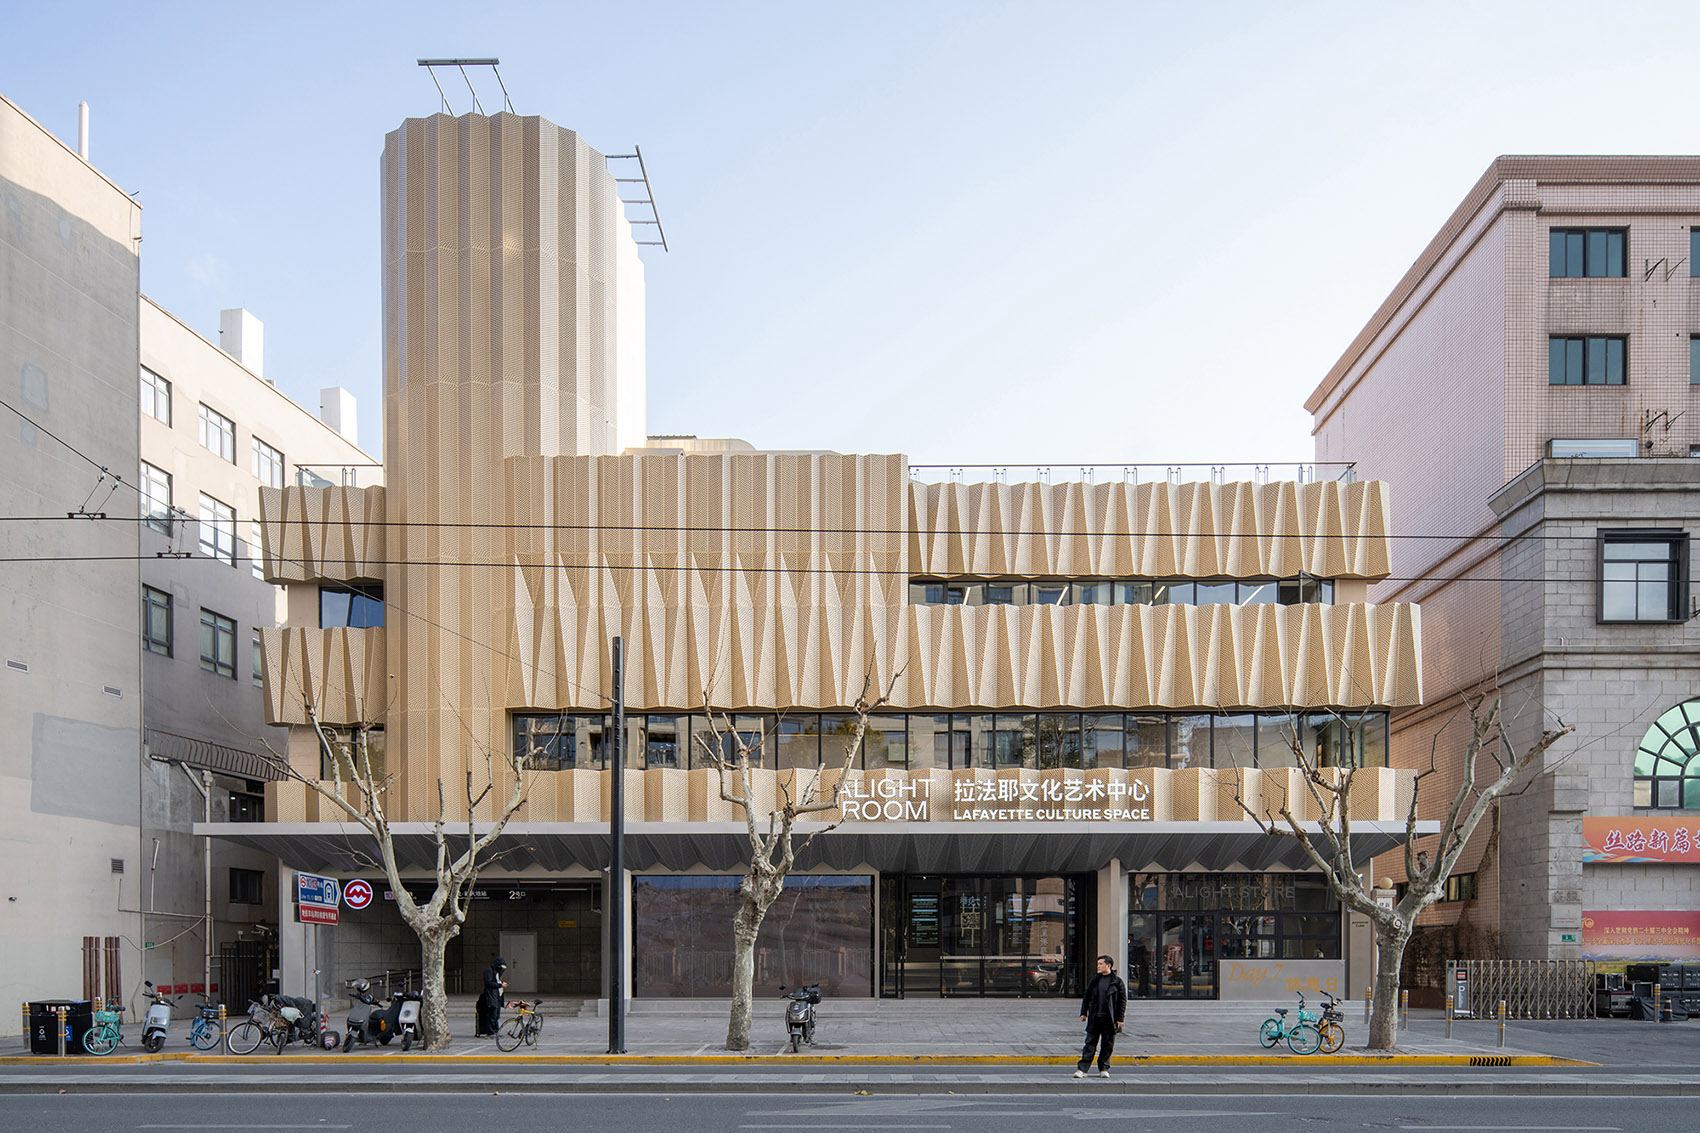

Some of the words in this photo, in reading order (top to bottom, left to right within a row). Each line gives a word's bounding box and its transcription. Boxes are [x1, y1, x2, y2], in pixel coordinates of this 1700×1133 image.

[838, 778, 936, 798] ALIGHT
[954, 778, 1150, 802] 拉法耶文化艺术中心
[842, 800, 927, 820] ROOM
[953, 809, 1034, 820] LAFAYETTE
[1036, 809, 1101, 820] CULTURE
[1104, 809, 1150, 820] SPACE
[1174, 886, 1235, 898] ALIGHT
[1239, 886, 1295, 898] STORE
[1228, 964, 1268, 988] Day
[1272, 964, 1284, 982] 7
